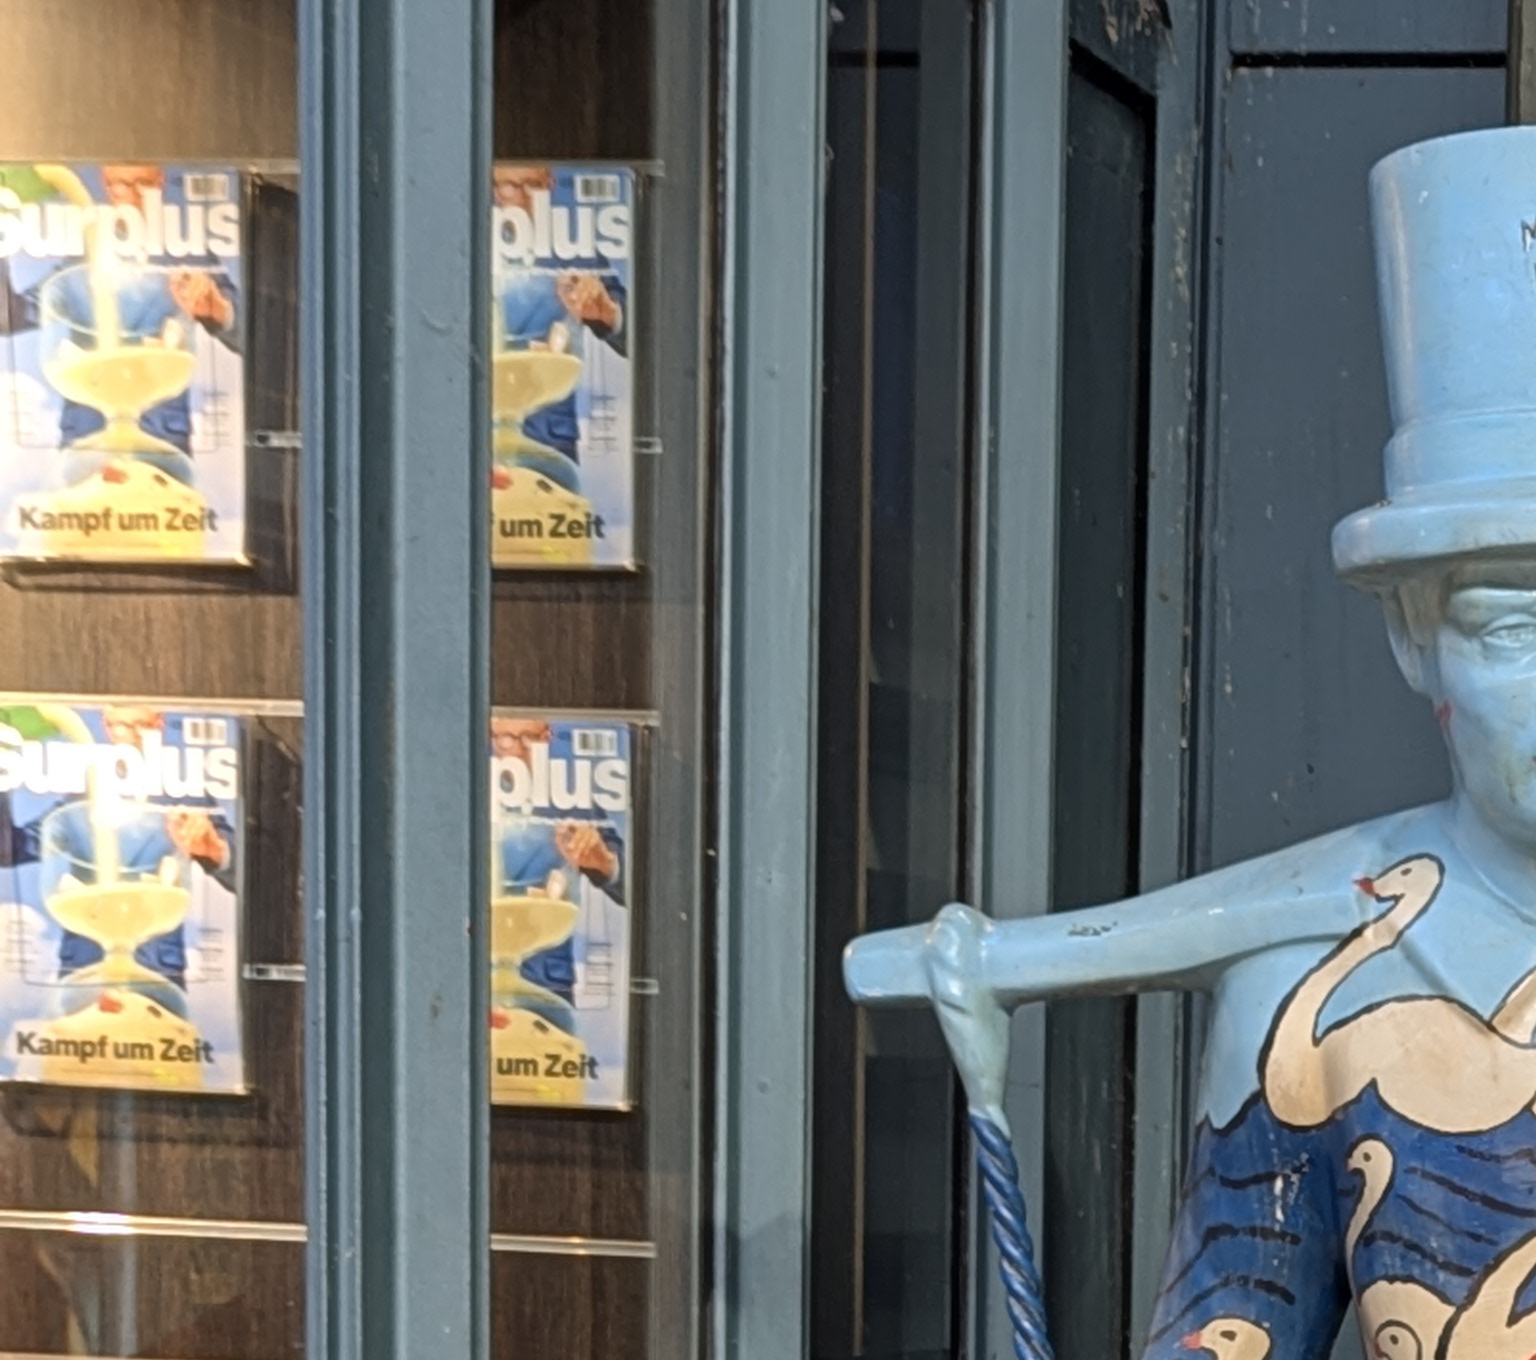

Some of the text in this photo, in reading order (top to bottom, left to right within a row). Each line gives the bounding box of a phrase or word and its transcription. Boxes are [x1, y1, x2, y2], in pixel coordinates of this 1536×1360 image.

[19, 507, 218, 537] Kampf um Zeit
[499, 513, 605, 539] um Zeit
[16, 1031, 214, 1063] Kampf um Zeit
[496, 1054, 599, 1080] um Zeit
